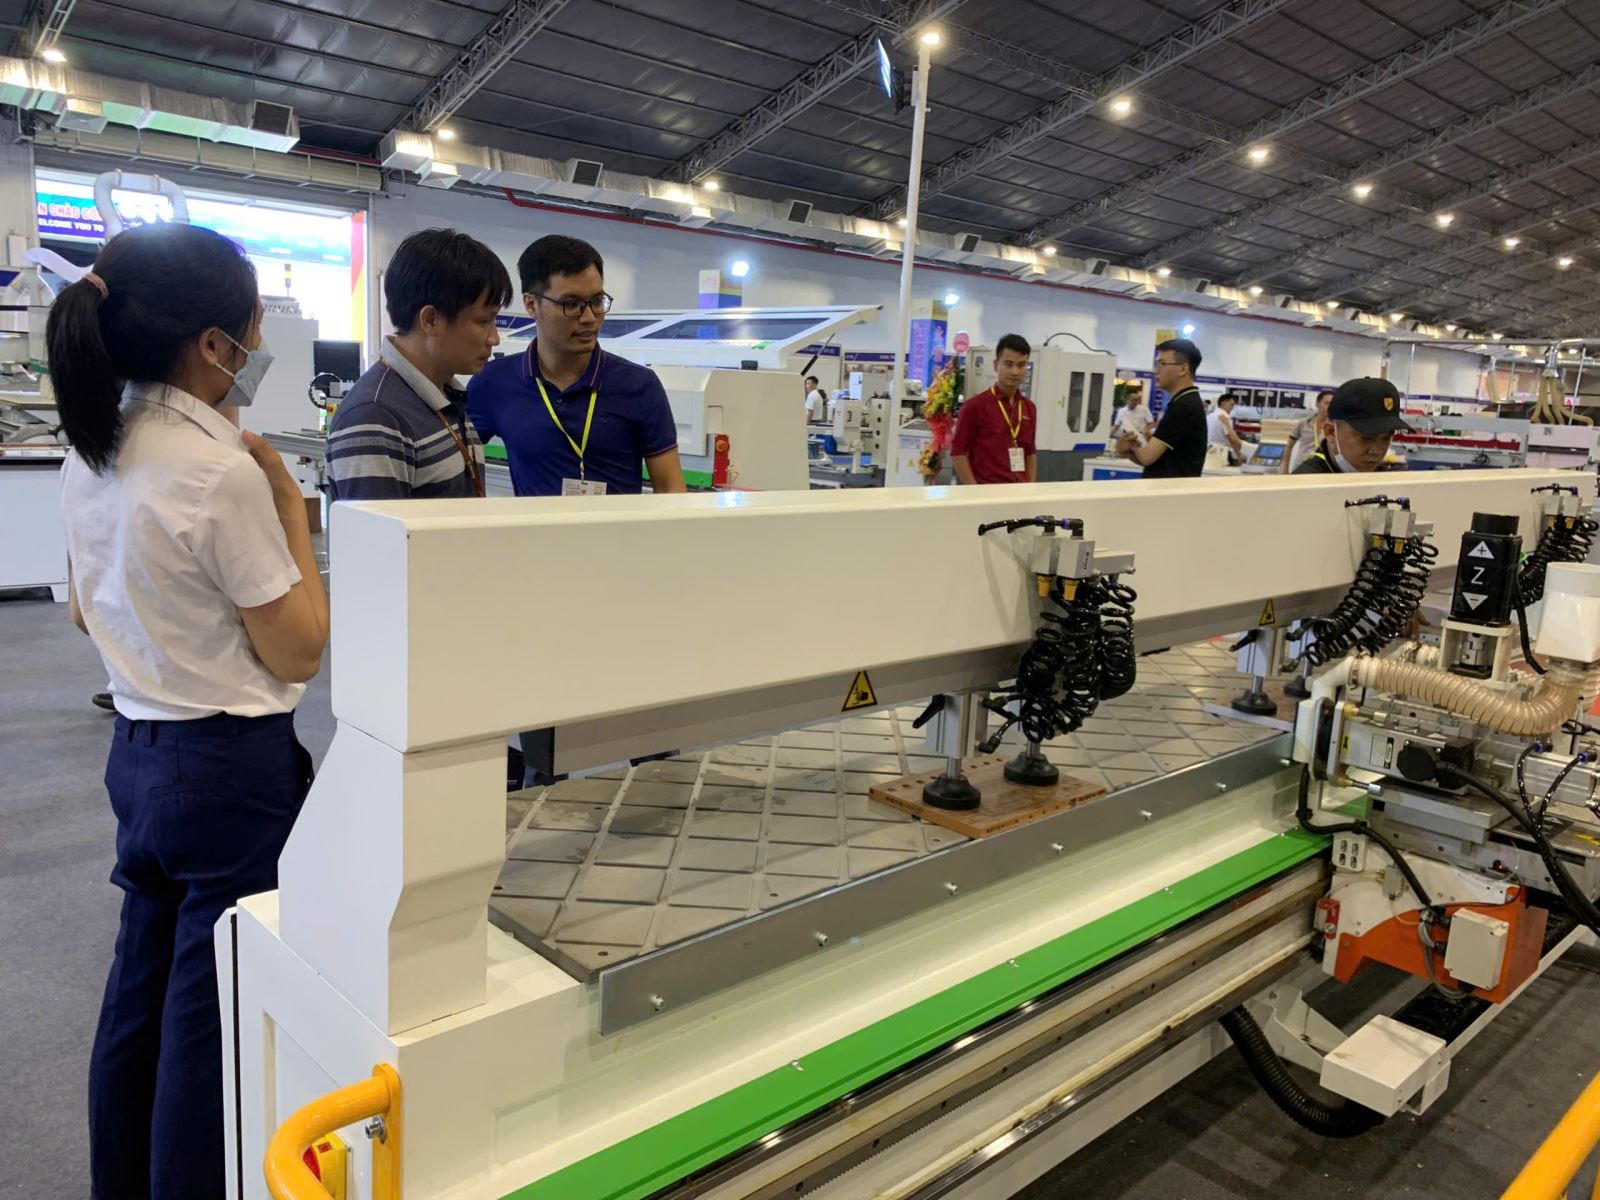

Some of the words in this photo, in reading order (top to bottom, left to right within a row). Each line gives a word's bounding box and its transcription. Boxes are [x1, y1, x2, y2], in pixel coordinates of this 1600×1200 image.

[39, 218, 72, 228] ELCOME
[75, 222, 91, 230] YOU
[93, 224, 104, 232] TO
[1471, 566, 1485, 585] Z
